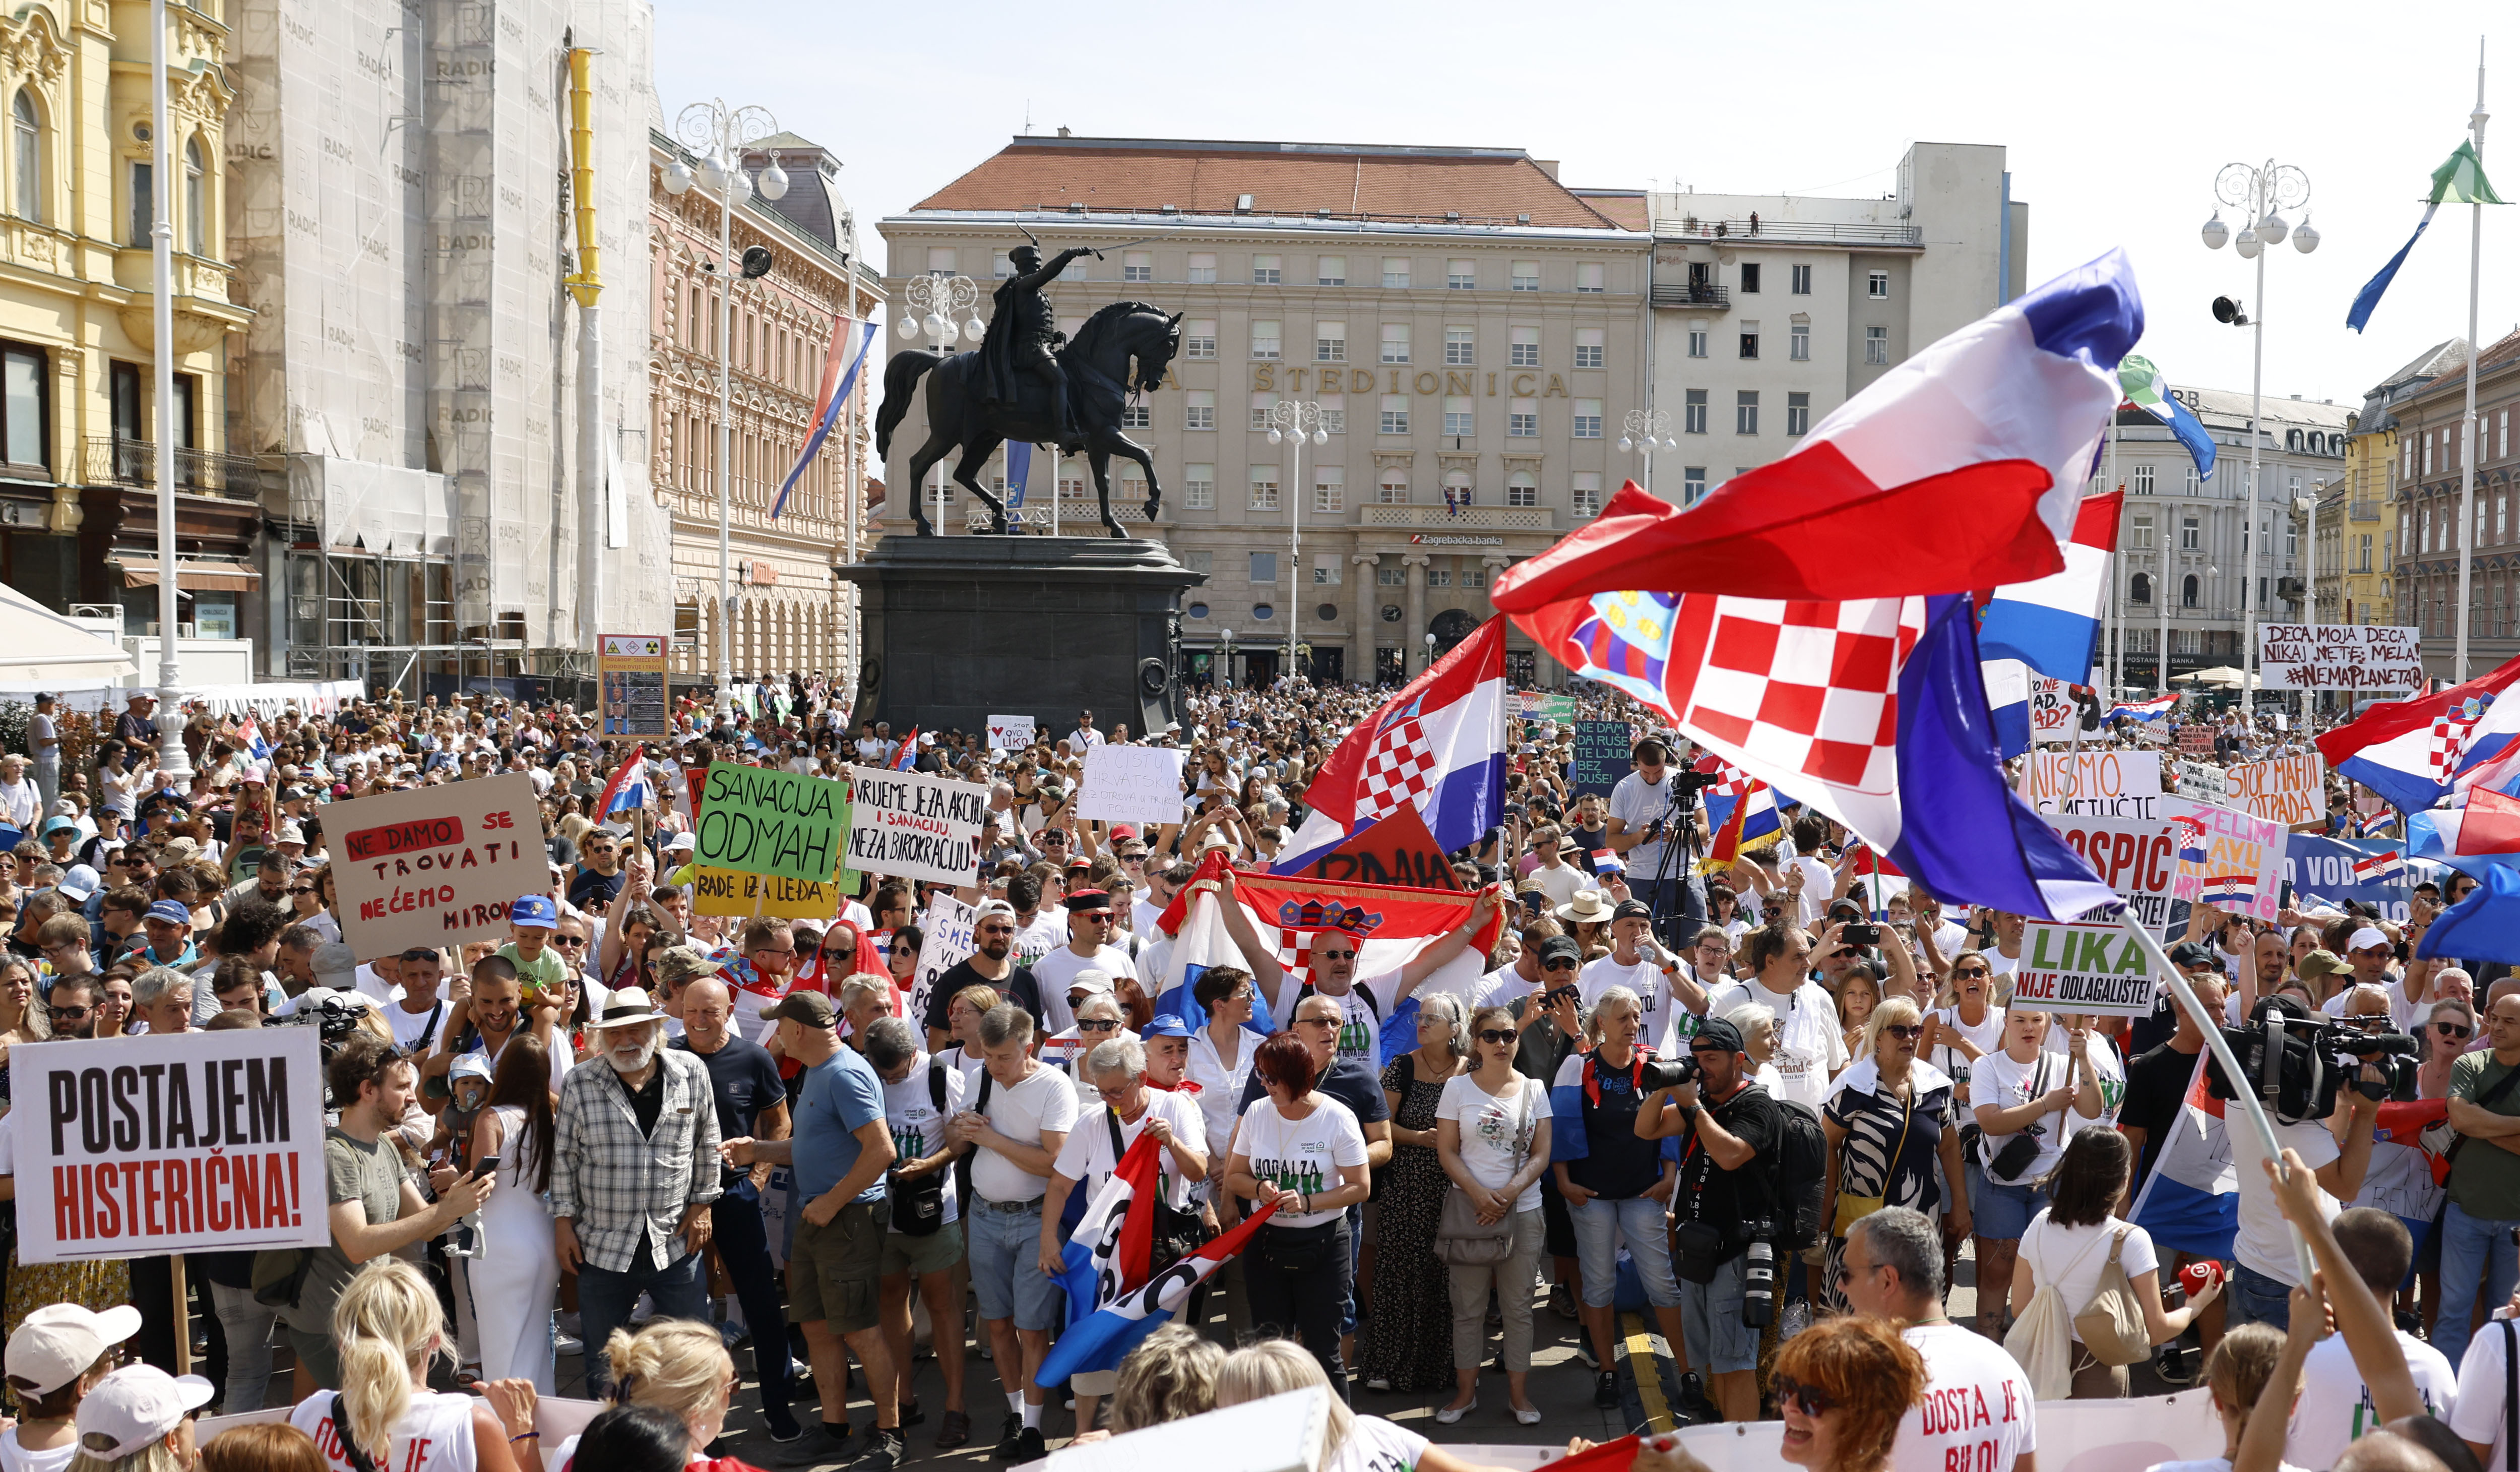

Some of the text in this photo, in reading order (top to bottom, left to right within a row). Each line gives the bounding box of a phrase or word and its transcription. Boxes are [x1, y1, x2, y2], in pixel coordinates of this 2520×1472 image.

[328, 327, 355, 353] RADIĆ
[1255, 363, 1568, 397] ŠTEDIONICA
[1422, 534, 1502, 546] Zagrebačka banka
[752, 562, 778, 585] Müller
[2267, 626, 2407, 646] DECA, MOJA DECA
[2264, 644, 2306, 662] NIKAJ
[2372, 643, 2420, 662] MELA!
[2042, 678, 2059, 690] NE
[2034, 693, 2058, 709] AD,
[2034, 704, 2071, 726] AD?
[1577, 723, 1624, 733] NE DAM
[1577, 733, 1628, 746] DA RUŠE
[1002, 738, 1028, 747] LIKO
[1577, 748, 1630, 759] TE LJUDI
[1086, 748, 1165, 772] ZA ČISTU
[1578, 761, 1601, 771] BEZ
[1578, 770, 1612, 783] DUŠE!
[2030, 754, 2121, 798] NISMO
[2227, 761, 2267, 799] STOP
[2274, 754, 2318, 792] MAFIJI
[708, 770, 833, 820] SANACIJA
[854, 778, 908, 812] VRIJEME
[948, 790, 984, 825] AKCIJU
[1101, 791, 1136, 802] OTROVA
[2247, 791, 2316, 824] OTPADA
[877, 811, 881, 822] I
[2190, 803, 2277, 848] ŽELIM
[348, 811, 514, 856] NE DAMO SE
[700, 811, 830, 875] ODMAH
[697, 875, 824, 903] RADE IZA LEĐA
[360, 885, 455, 921] NEĆEMO
[2031, 929, 2147, 976] LIKA
[2016, 972, 2151, 1005] NIJE ODLAGALIŠTE!
[48, 1057, 290, 1156] POSTAJEM
[1300, 1160, 1320, 1178] ZA
[52, 1147, 302, 1242] HISTERIČNA!
[1922, 1379, 2017, 1436] DOSTA JE
